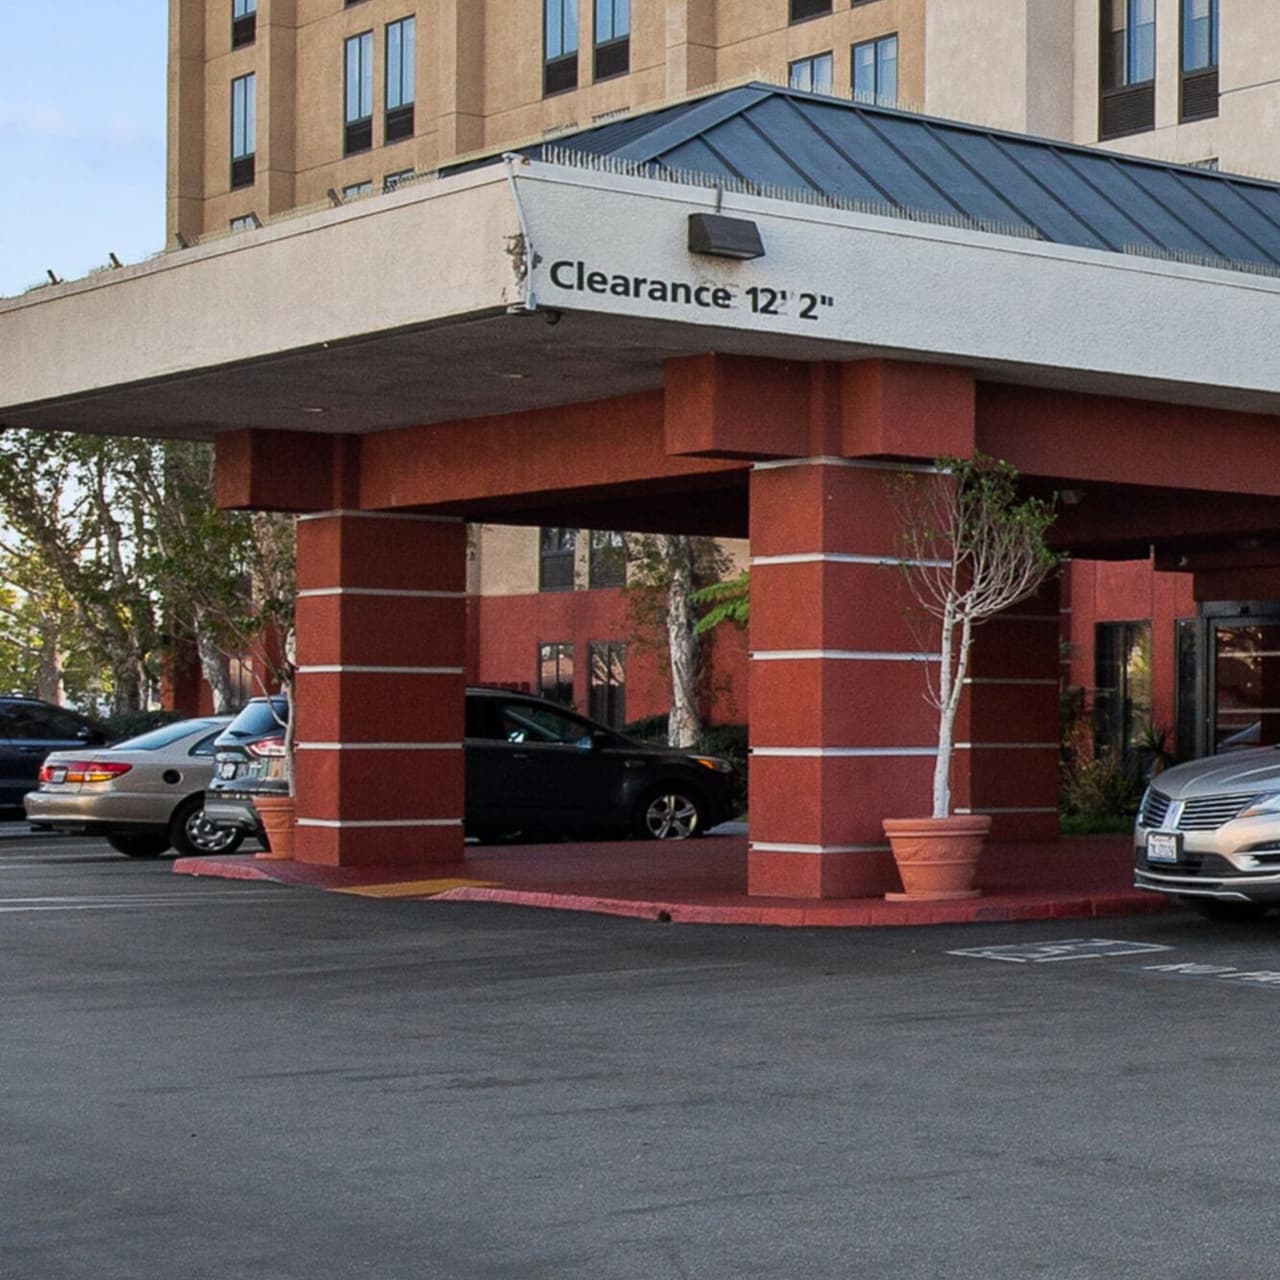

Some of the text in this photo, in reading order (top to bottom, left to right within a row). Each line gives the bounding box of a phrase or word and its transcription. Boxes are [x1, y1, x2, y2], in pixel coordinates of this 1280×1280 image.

[550, 260, 834, 320] Clearance 12' 2"
[1142, 962, 1238, 974] NO
